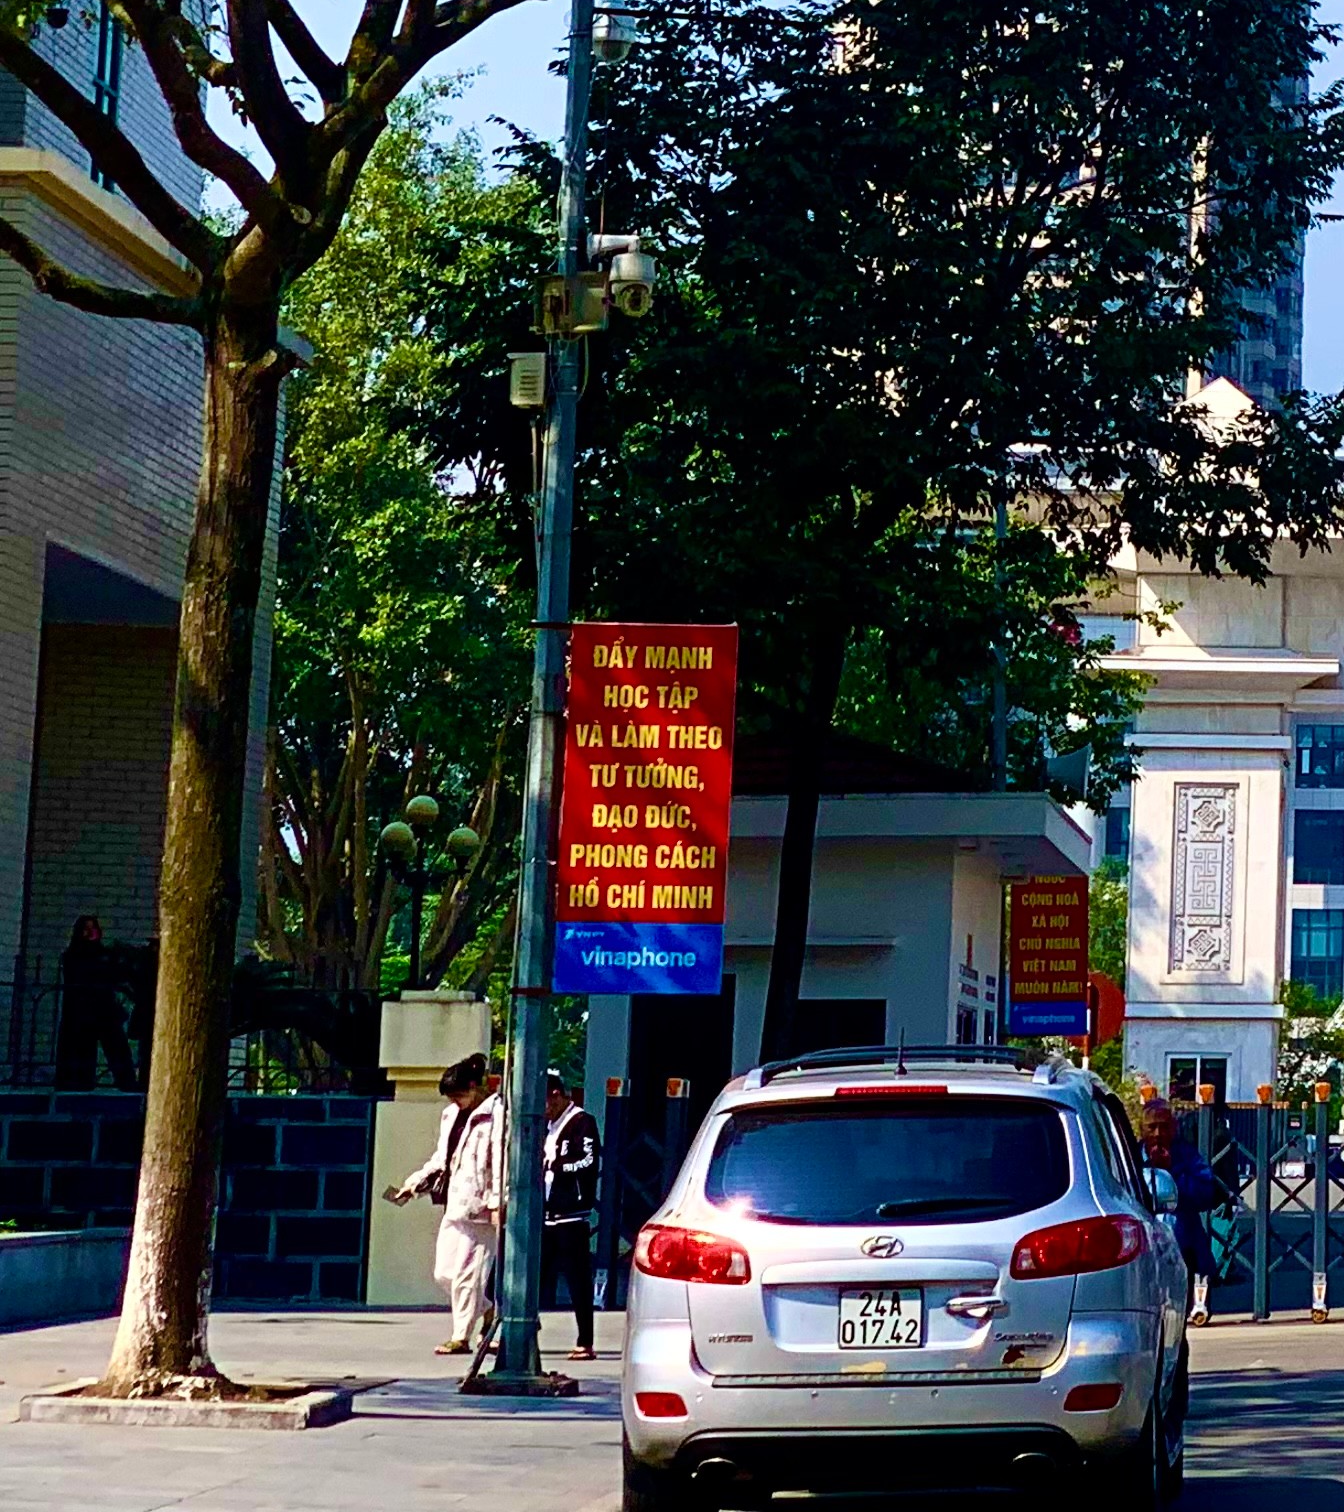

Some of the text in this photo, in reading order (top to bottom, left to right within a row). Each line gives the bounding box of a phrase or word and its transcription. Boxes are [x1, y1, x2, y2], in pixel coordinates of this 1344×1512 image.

[593, 635, 713, 674] ĐẨY MẠNH
[603, 681, 699, 714] HỌC TẬP
[575, 719, 723, 750] VÀ LÀM THEO
[589, 757, 705, 792] TƯ TƯỞNG,
[591, 800, 697, 833] ĐẠO ĐỨC,
[569, 839, 716, 870] PHONG CÁCH
[568, 876, 714, 909] HỒ CHÍ MINH
[581, 945, 697, 970] vinaphone
[860, 1291, 902, 1317] 24A
[841, 1319, 918, 1344] 017.42
